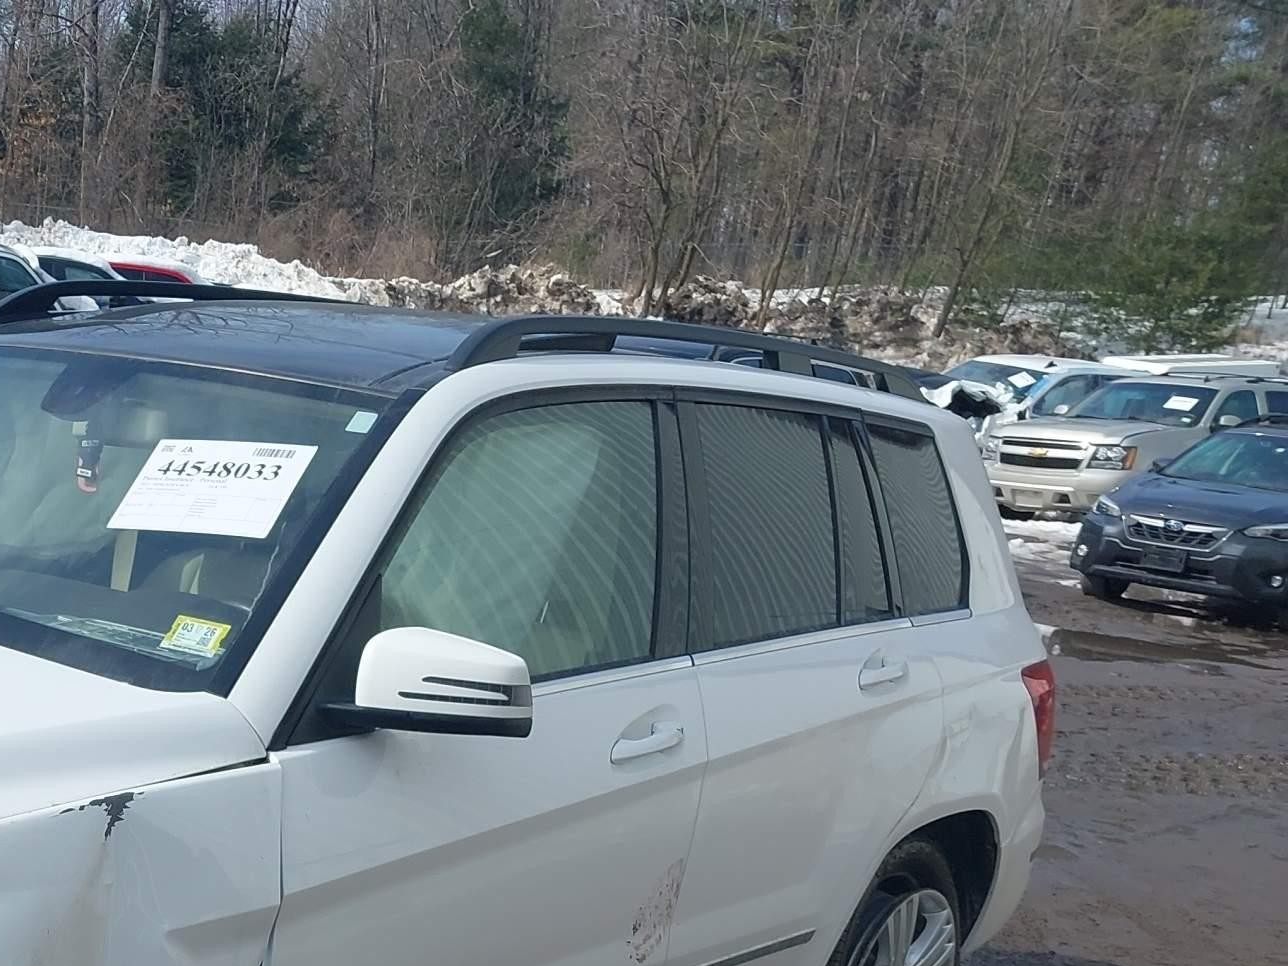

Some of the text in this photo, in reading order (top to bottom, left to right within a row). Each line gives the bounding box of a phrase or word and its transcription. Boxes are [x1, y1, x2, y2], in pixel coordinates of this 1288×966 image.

[157, 459, 282, 481] 44548033
[182, 622, 217, 637] 03 26
